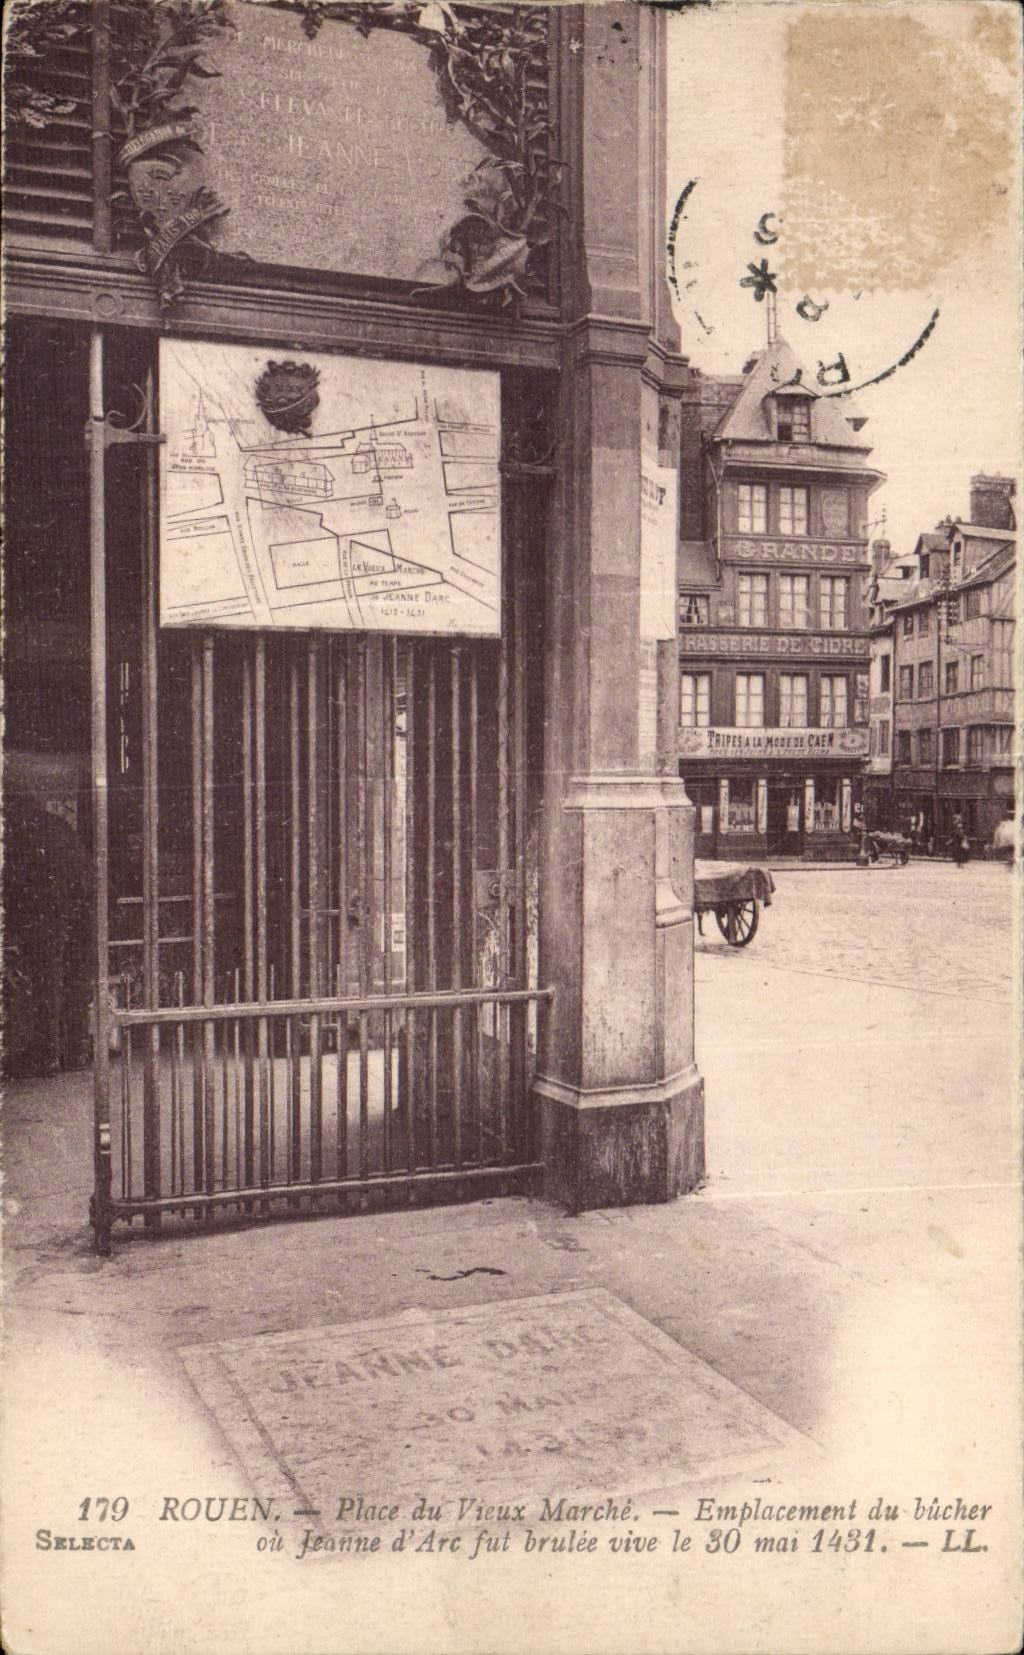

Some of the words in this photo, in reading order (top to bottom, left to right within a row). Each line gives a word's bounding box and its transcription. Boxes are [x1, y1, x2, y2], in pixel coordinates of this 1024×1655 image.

[735, 540, 857, 562] GRANDE
[382, 592, 420, 602] JEANNE
[681, 634, 770, 653] RASSERIE
[776, 636, 803, 653] DE
[810, 637, 866, 655] CIDRE
[708, 730, 742, 749] TRIPES
[765, 734, 791, 748] MODE
[793, 737, 805, 748] DE
[807, 731, 835, 748] CAEN
[268, 1345, 464, 1395] JEANNE
